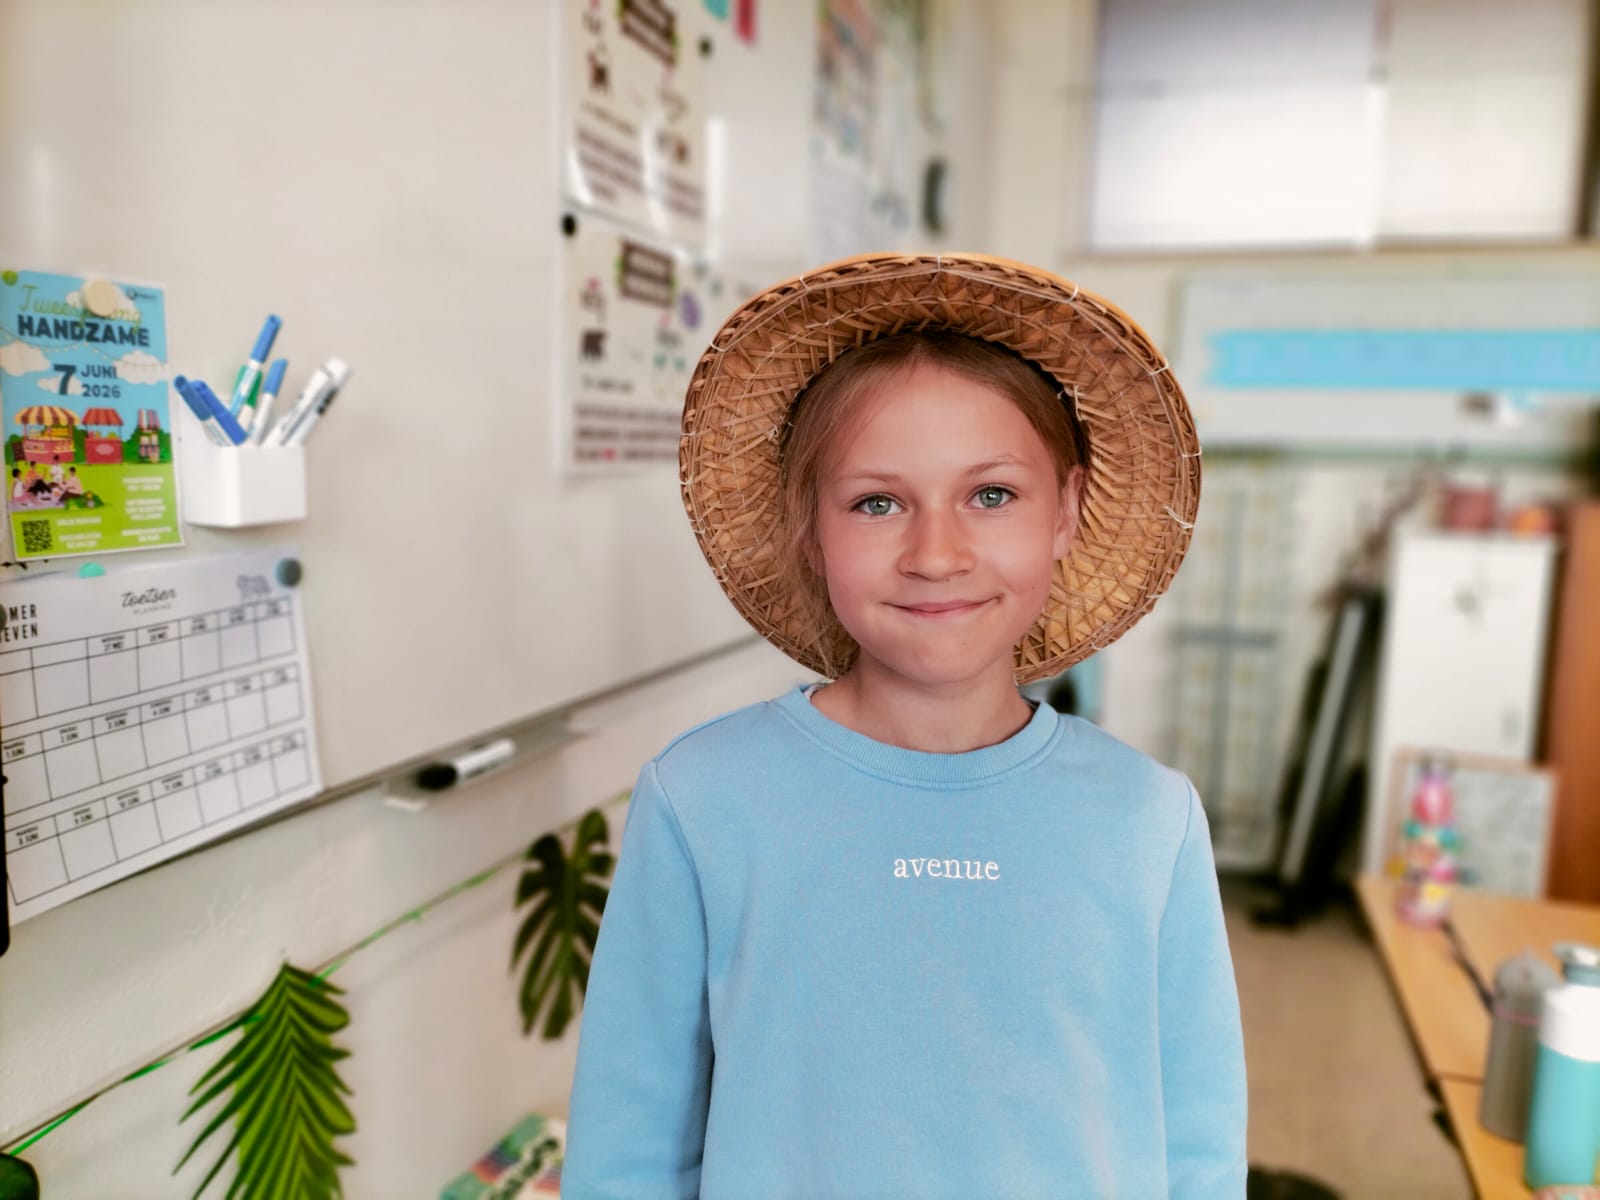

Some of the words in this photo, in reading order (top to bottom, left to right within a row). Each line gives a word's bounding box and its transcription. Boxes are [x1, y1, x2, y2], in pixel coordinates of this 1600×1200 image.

[17, 314, 150, 347] HANDZAME
[53, 363, 77, 396] 7
[81, 364, 118, 380] JUNI
[81, 383, 121, 399] 2026
[9, 603, 37, 620] MER
[0, 622, 38, 642] EVEN
[894, 857, 1001, 880] avenue
